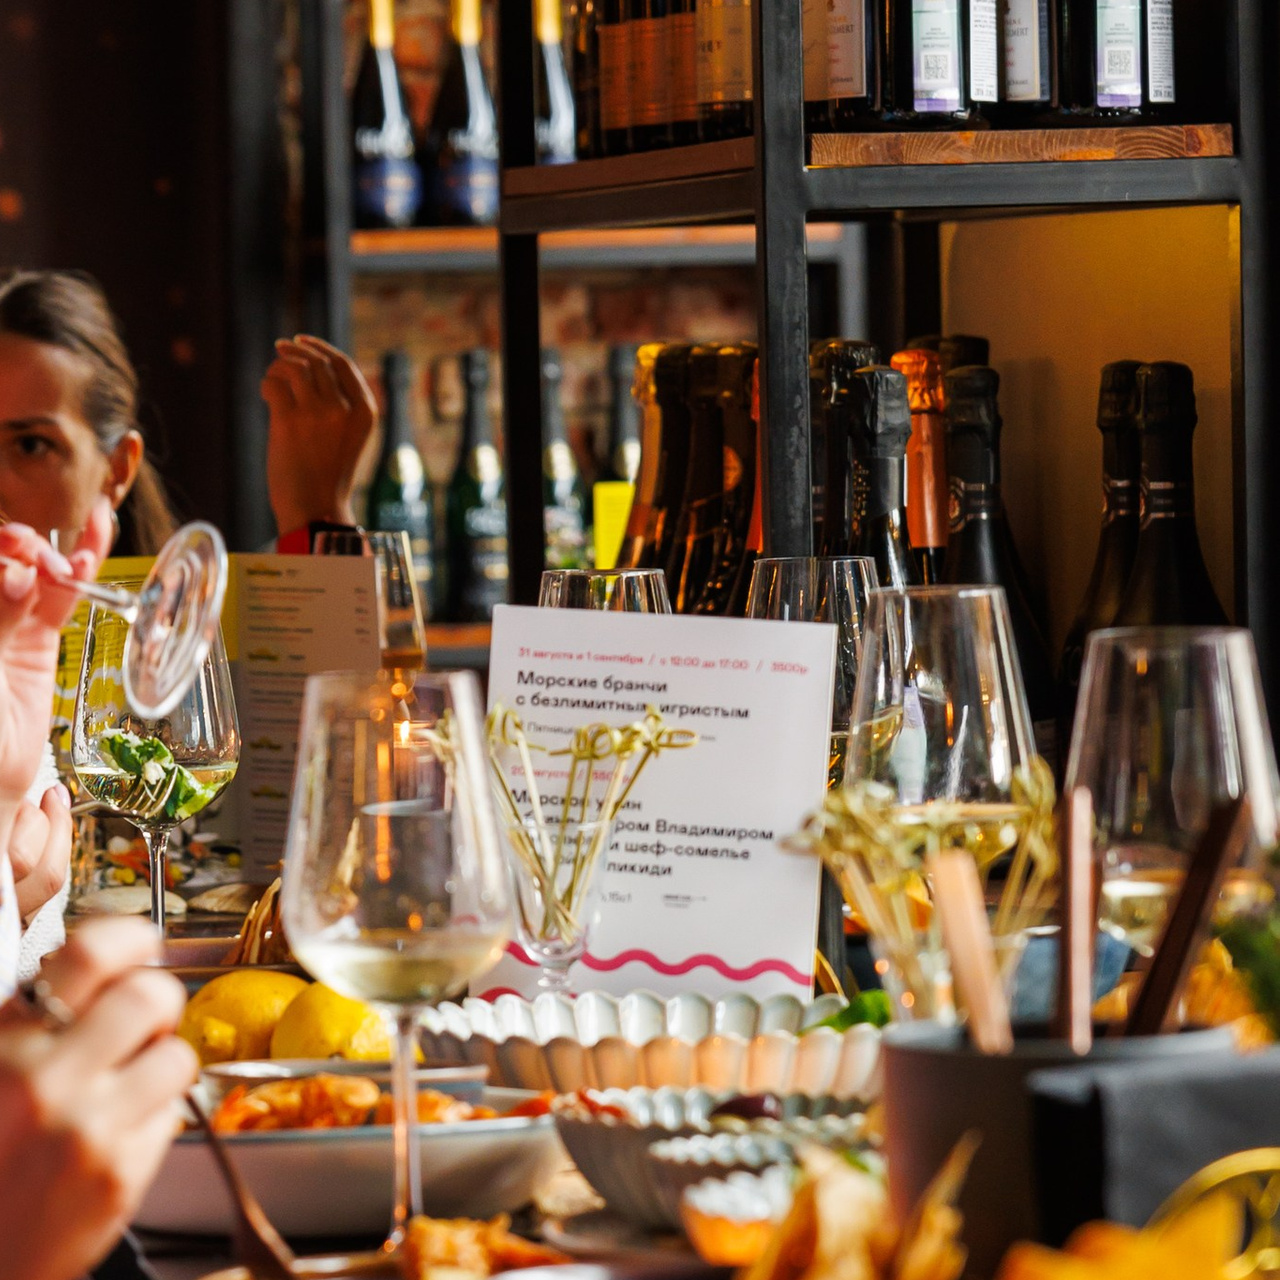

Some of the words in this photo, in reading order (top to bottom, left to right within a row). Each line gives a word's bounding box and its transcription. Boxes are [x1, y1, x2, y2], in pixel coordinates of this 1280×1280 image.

[533, 650, 573, 661] августа
[593, 652, 644, 665] сентября
[702, 660, 715, 669] до
[517, 670, 598, 689] Морские
[603, 675, 668, 693] бранчи
[516, 695, 526, 706] с
[659, 703, 749, 719] игристым
[655, 819, 774, 841] Владимиром
[624, 840, 751, 860] шеф-сомелье
